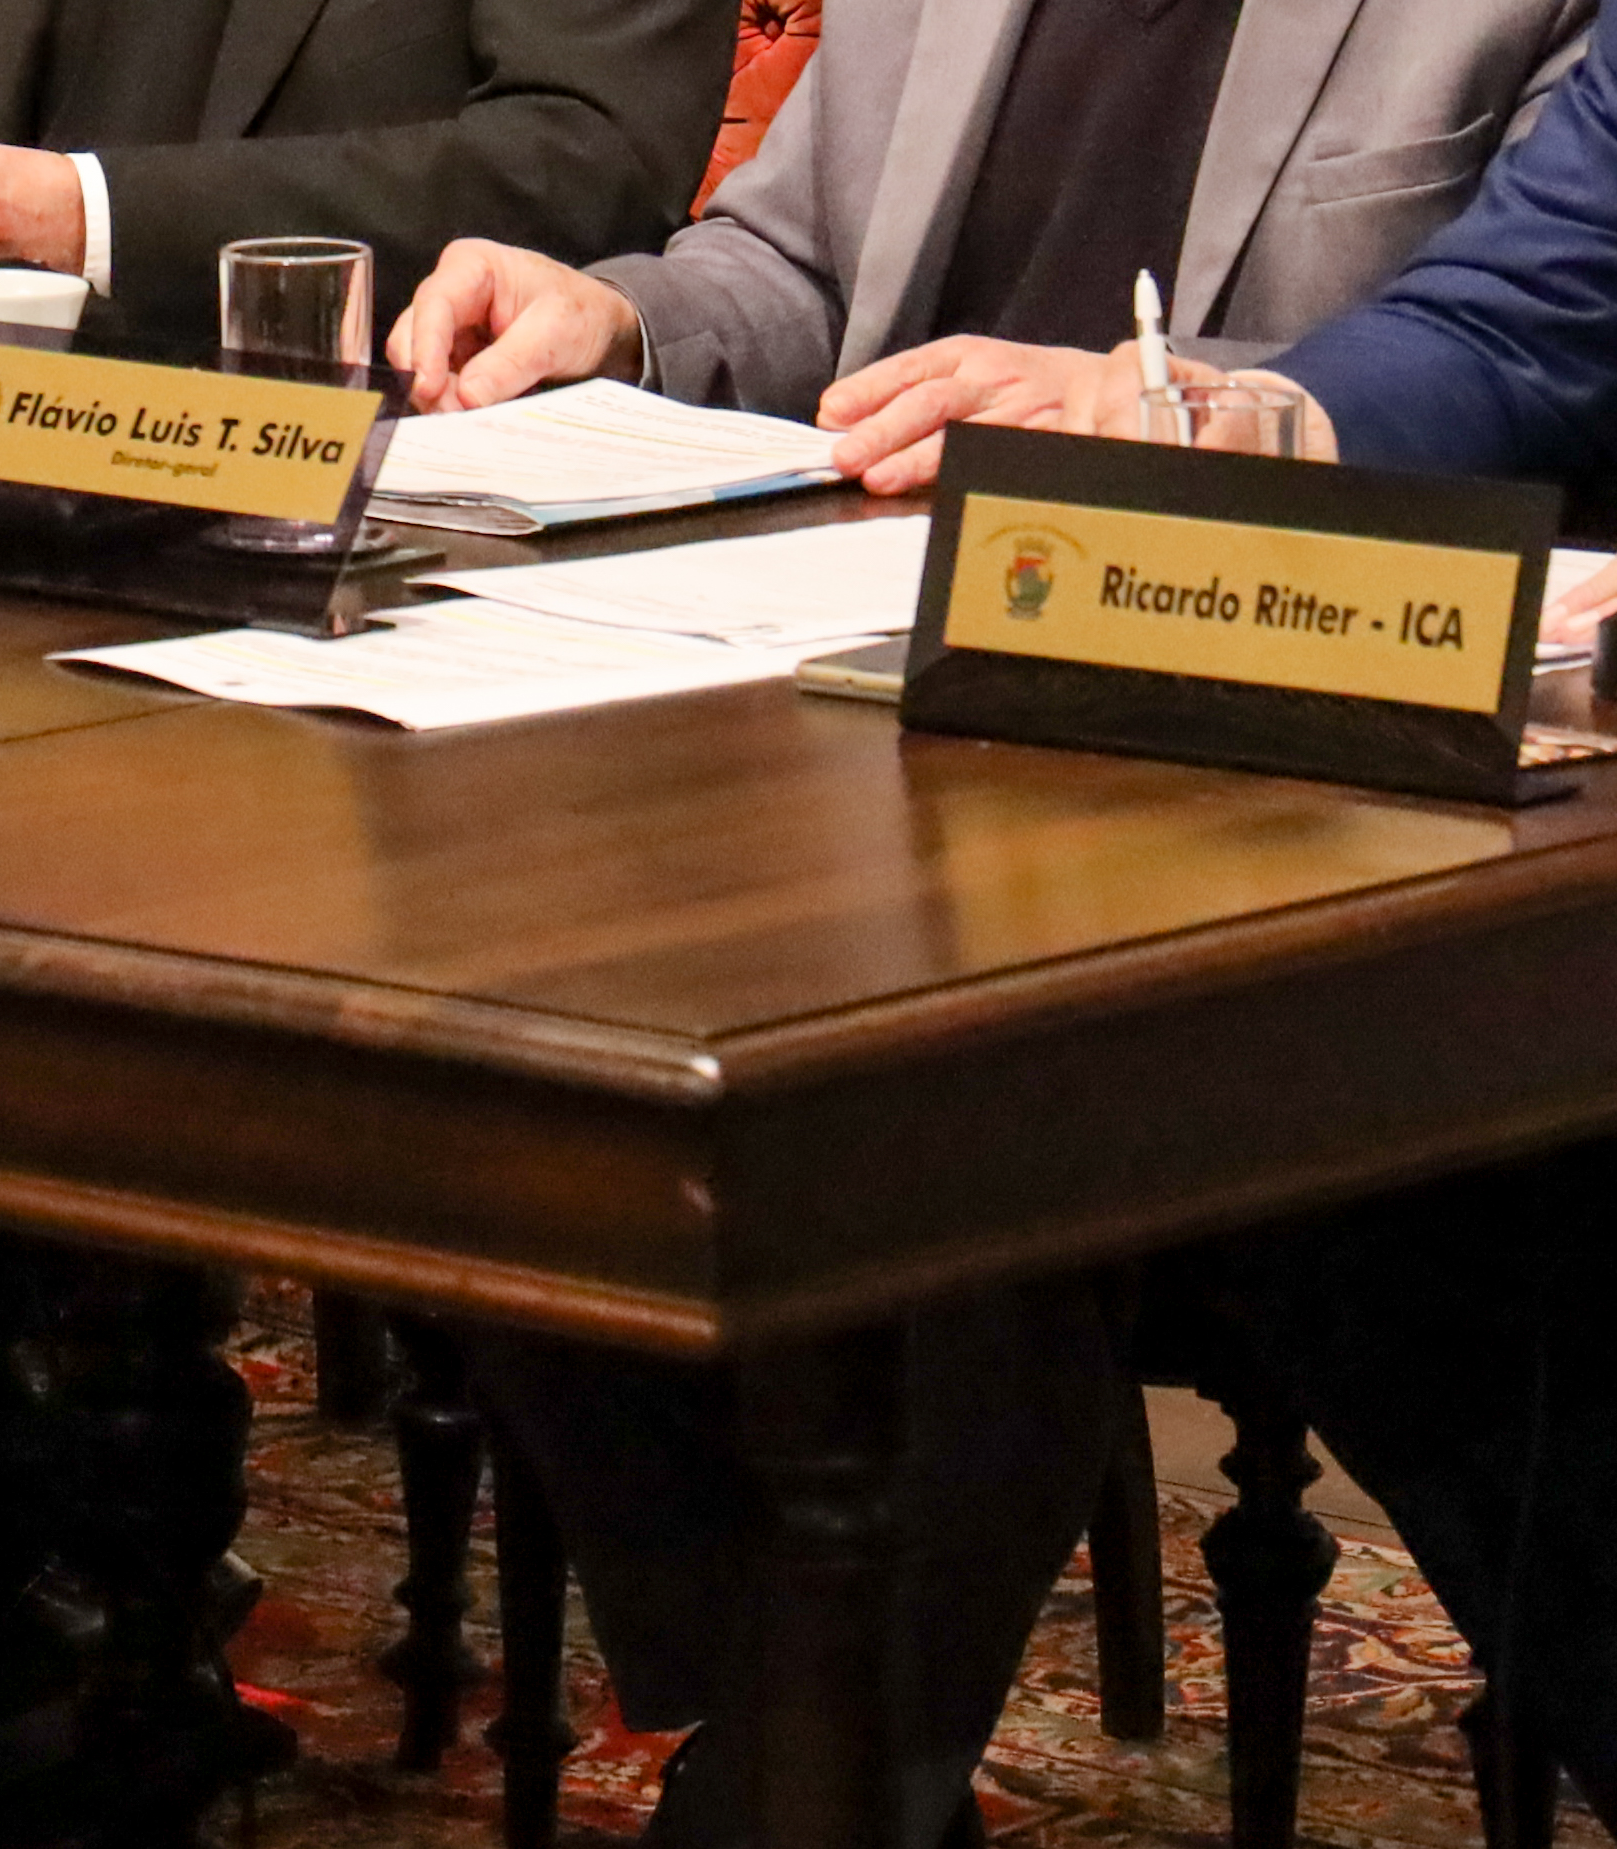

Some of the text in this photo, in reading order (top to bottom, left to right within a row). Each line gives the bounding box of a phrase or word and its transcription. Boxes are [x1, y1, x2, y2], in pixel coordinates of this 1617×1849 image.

[7, 392, 346, 464] Flávio Luis T. Silva
[1099, 564, 1241, 623] Ricardo
[1253, 583, 1359, 636] Ritter
[1399, 600, 1463, 651] ICA
